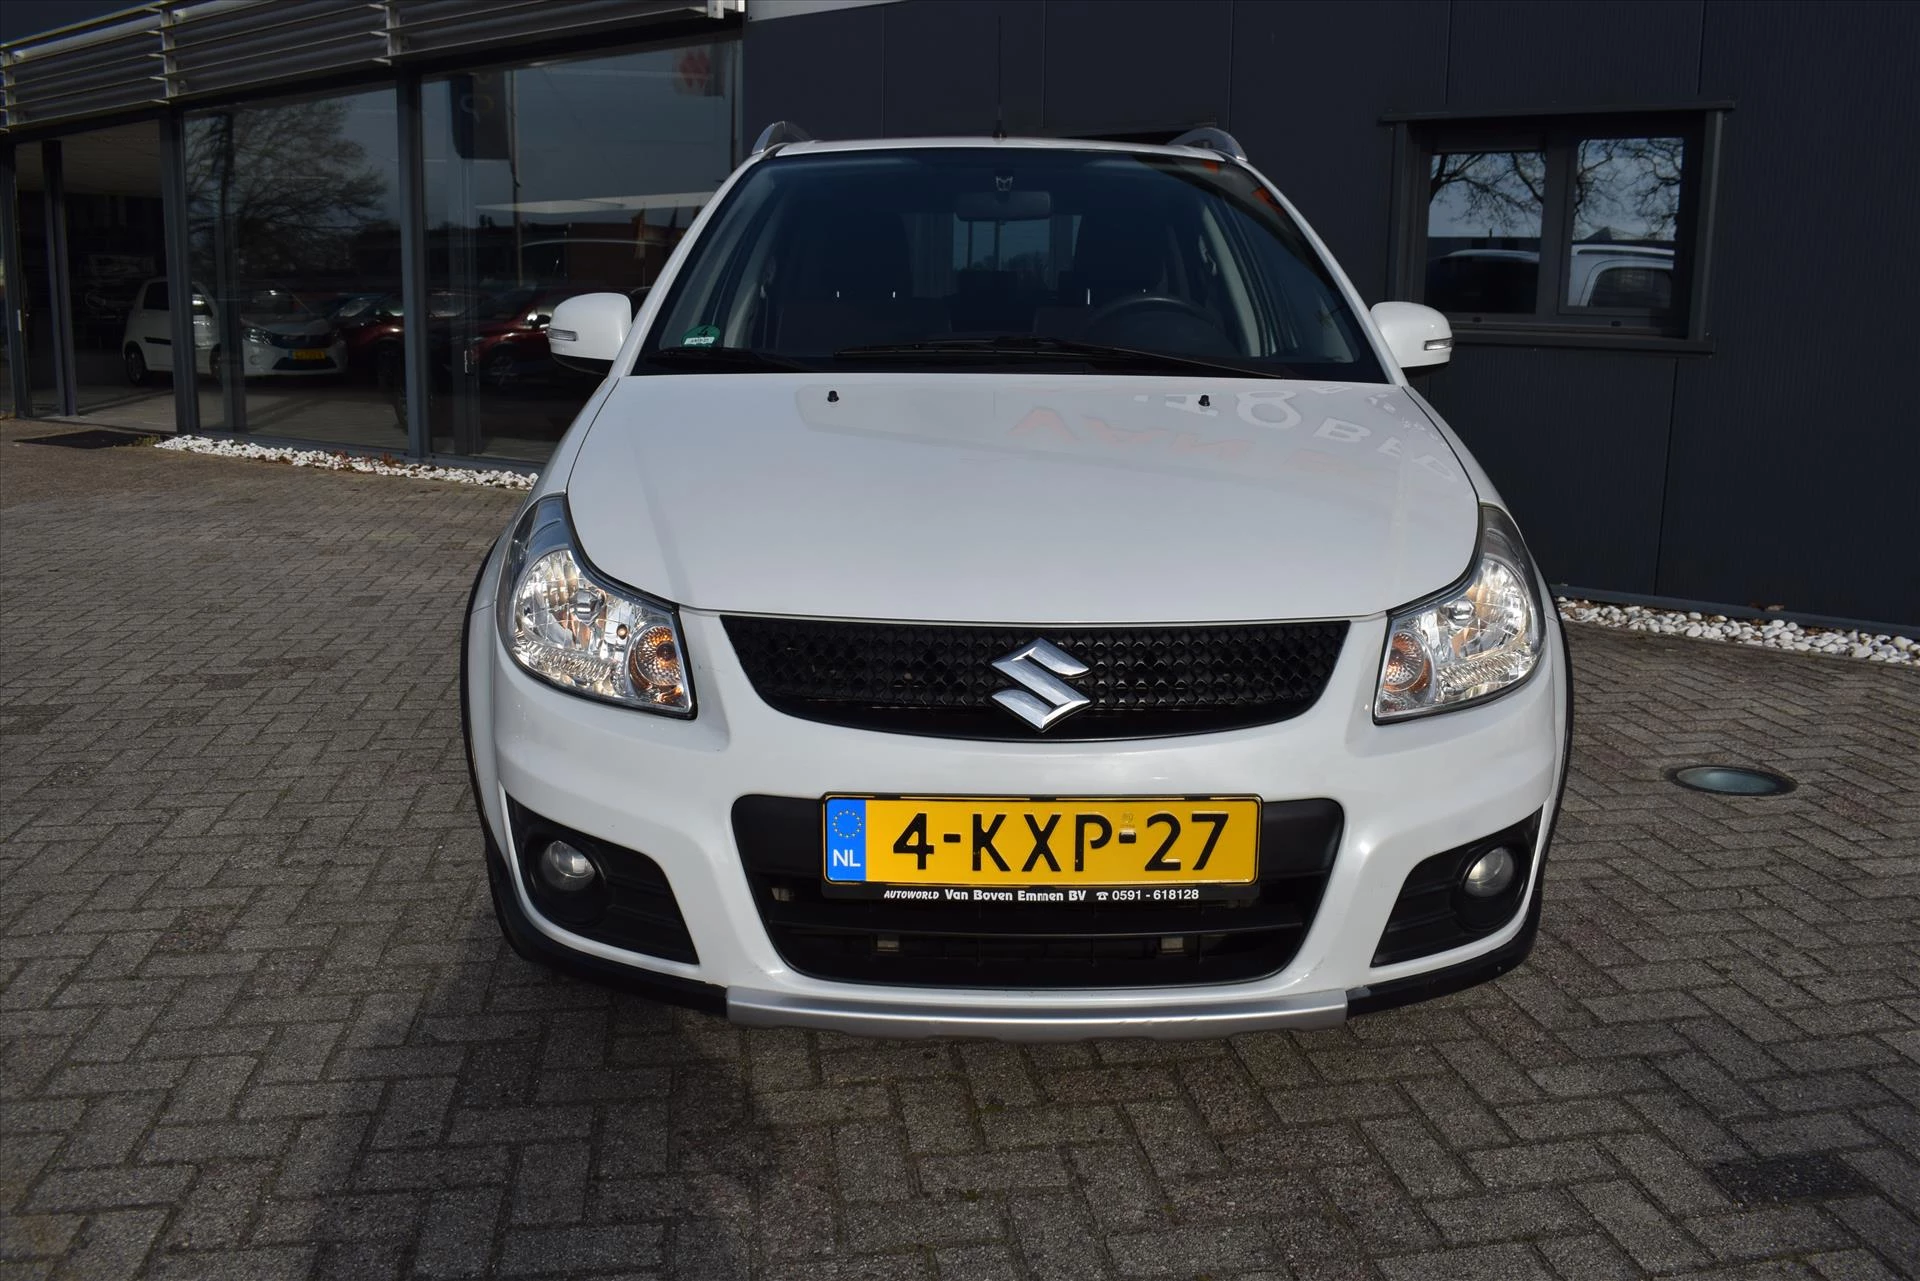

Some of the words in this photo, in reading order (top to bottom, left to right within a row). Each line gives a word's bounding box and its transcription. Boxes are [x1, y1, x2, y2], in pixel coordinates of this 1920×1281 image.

[893, 811, 1229, 872] 4-KXP-27
[832, 849, 861, 868] NL
[883, 890, 940, 900] AUTOWORLD
[944, 889, 969, 900] Van
[973, 889, 1013, 901] Boven
[1017, 890, 1064, 901] Emmen
[1068, 890, 1087, 901] BV
[1111, 889, 1142, 901] 0591
[1153, 889, 1200, 900] 618128
